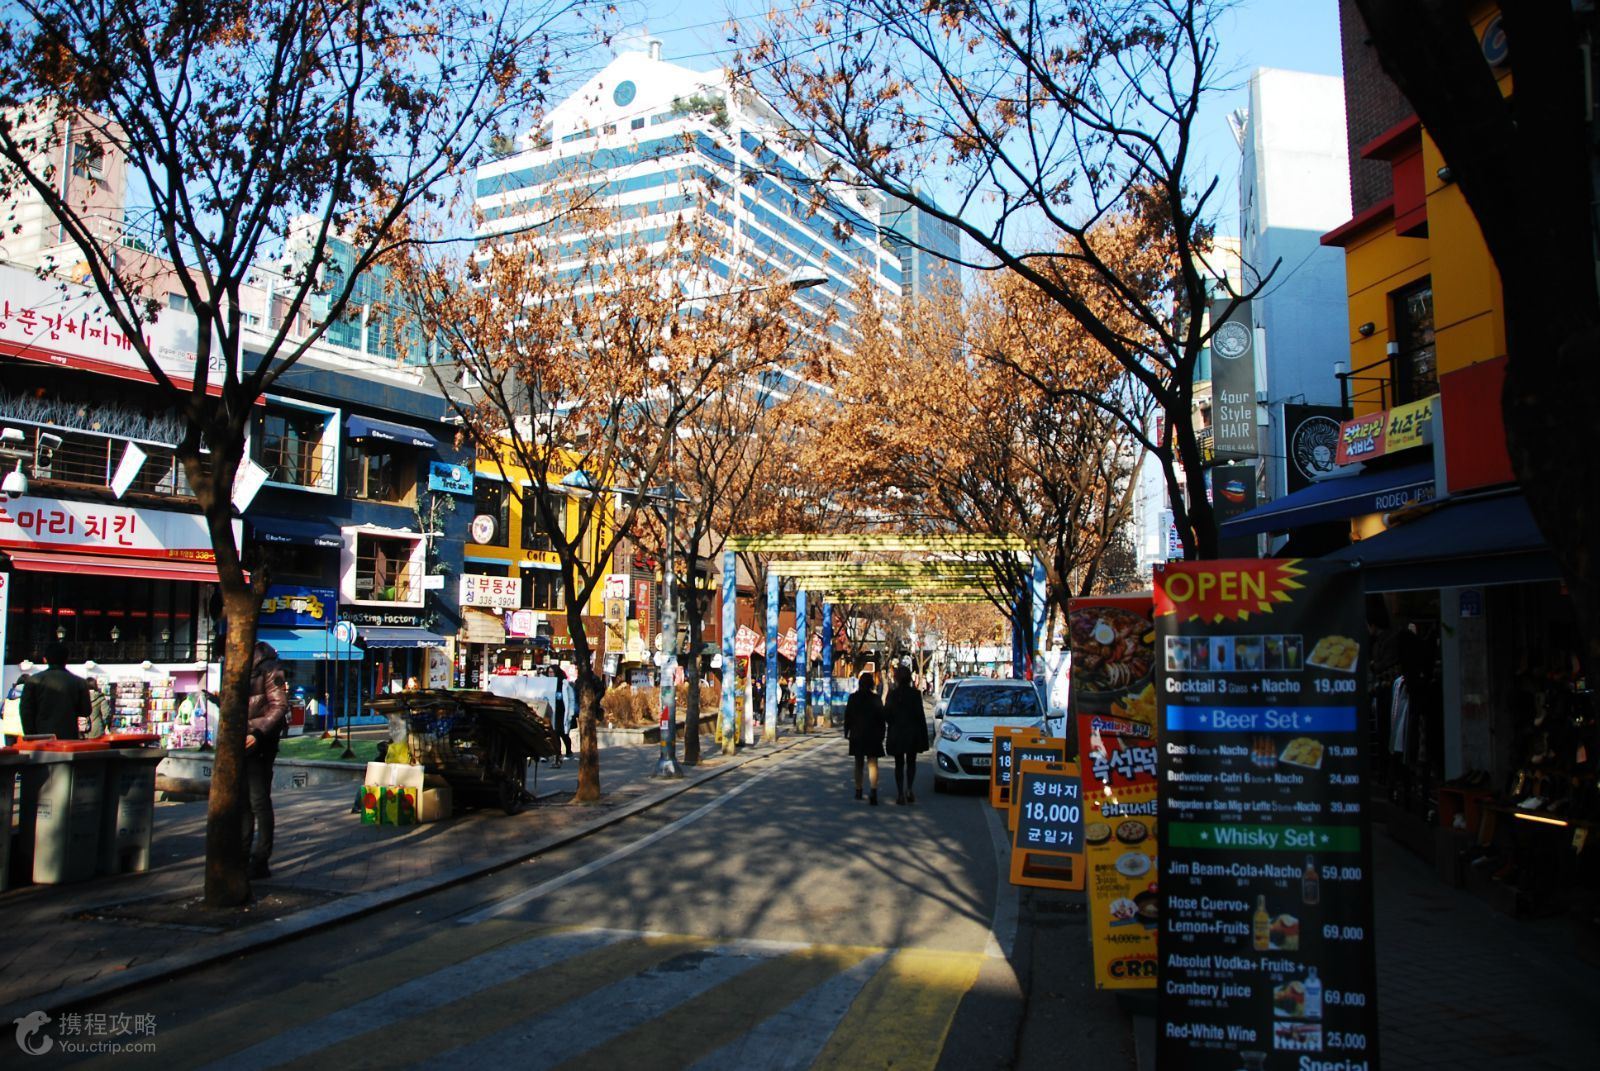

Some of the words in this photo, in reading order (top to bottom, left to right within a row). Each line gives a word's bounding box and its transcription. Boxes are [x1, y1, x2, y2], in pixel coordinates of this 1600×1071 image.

[1221, 390, 1249, 404] 4our
[1221, 406, 1252, 422] Style
[1221, 423, 1250, 438] HAIR
[1346, 436, 1375, 455] 서비스
[1376, 491, 1408, 509] RODEO
[84, 514, 136, 546] 치킨
[466, 577, 475, 603] 신성
[479, 578, 516, 595] 부동산
[1165, 570, 1267, 603] OPEN
[553, 636, 567, 645] EYE
[1166, 677, 1215, 694] Cocktail
[1218, 679, 1227, 693] 3
[1262, 678, 1301, 693] Nacho
[1314, 678, 1357, 695] 19,000
[1213, 710, 1258, 729] Beer
[1265, 711, 1300, 729] Set
[1167, 742, 1189, 756] Cass
[1219, 744, 1249, 757] Nacho
[1167, 770, 1213, 784] Budweiser
[1274, 773, 1304, 785] Nacho
[1033, 781, 1078, 799] 청바지
[1025, 802, 1079, 824] 18,000
[1028, 828, 1073, 845] 균일가
[1214, 827, 1279, 849] Whisky
[1284, 829, 1316, 847] Set
[1168, 861, 1189, 875] Jim
[1322, 866, 1362, 881] 59,000
[1168, 895, 1198, 910] Hose
[1323, 924, 1364, 941] 69,000
[1167, 953, 1211, 969] Absolut
[1260, 957, 1295, 973] Fruits
[1166, 979, 1219, 998] Cranbery
[1222, 981, 1252, 998] juice
[1324, 989, 1366, 1007] 69,000
[1166, 1022, 1225, 1040] Red-White
[1227, 1025, 1257, 1042] Wine
[1327, 1031, 1367, 1050] 25,000
[1299, 1055, 1368, 1071] Special
